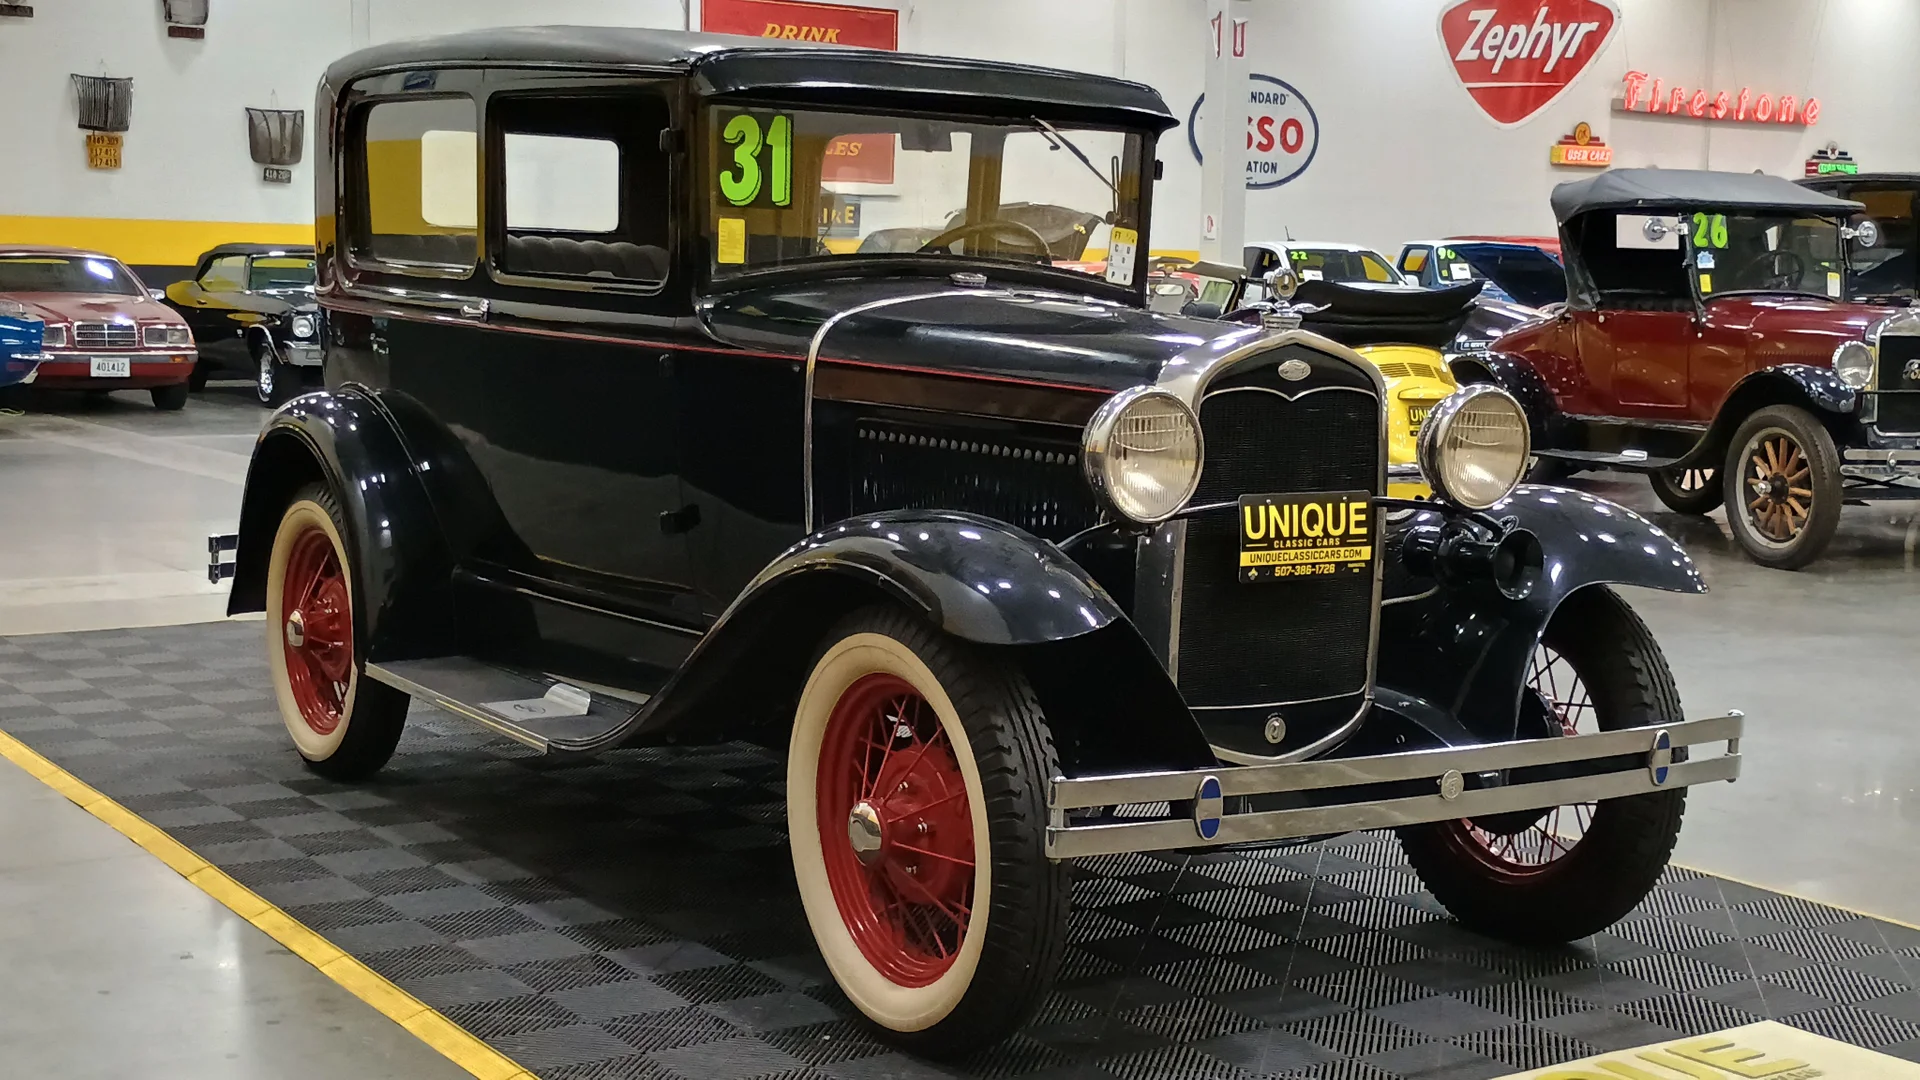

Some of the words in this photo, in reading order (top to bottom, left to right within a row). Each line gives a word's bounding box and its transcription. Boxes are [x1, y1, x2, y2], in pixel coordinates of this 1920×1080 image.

[761, 23, 841, 43] DRINK
[1455, 6, 1600, 75] Zephyr
[1248, 91, 1287, 106] NDARD
[1622, 70, 1821, 126] Firestone
[719, 114, 792, 207] 31
[1567, 148, 1588, 161] USED
[1589, 150, 1611, 161] CARS
[1693, 211, 1729, 249] 26
[1290, 251, 1308, 261] 22
[95, 362, 126, 373] 401412
[1243, 501, 1368, 540] UNIQUE
[1273, 539, 1313, 549] CLASSIC
[1316, 537, 1341, 547] CARS
[1249, 548, 1362, 564] UNIQUECLASSICCARS.COM
[1274, 563, 1336, 577] 507-386-1728
